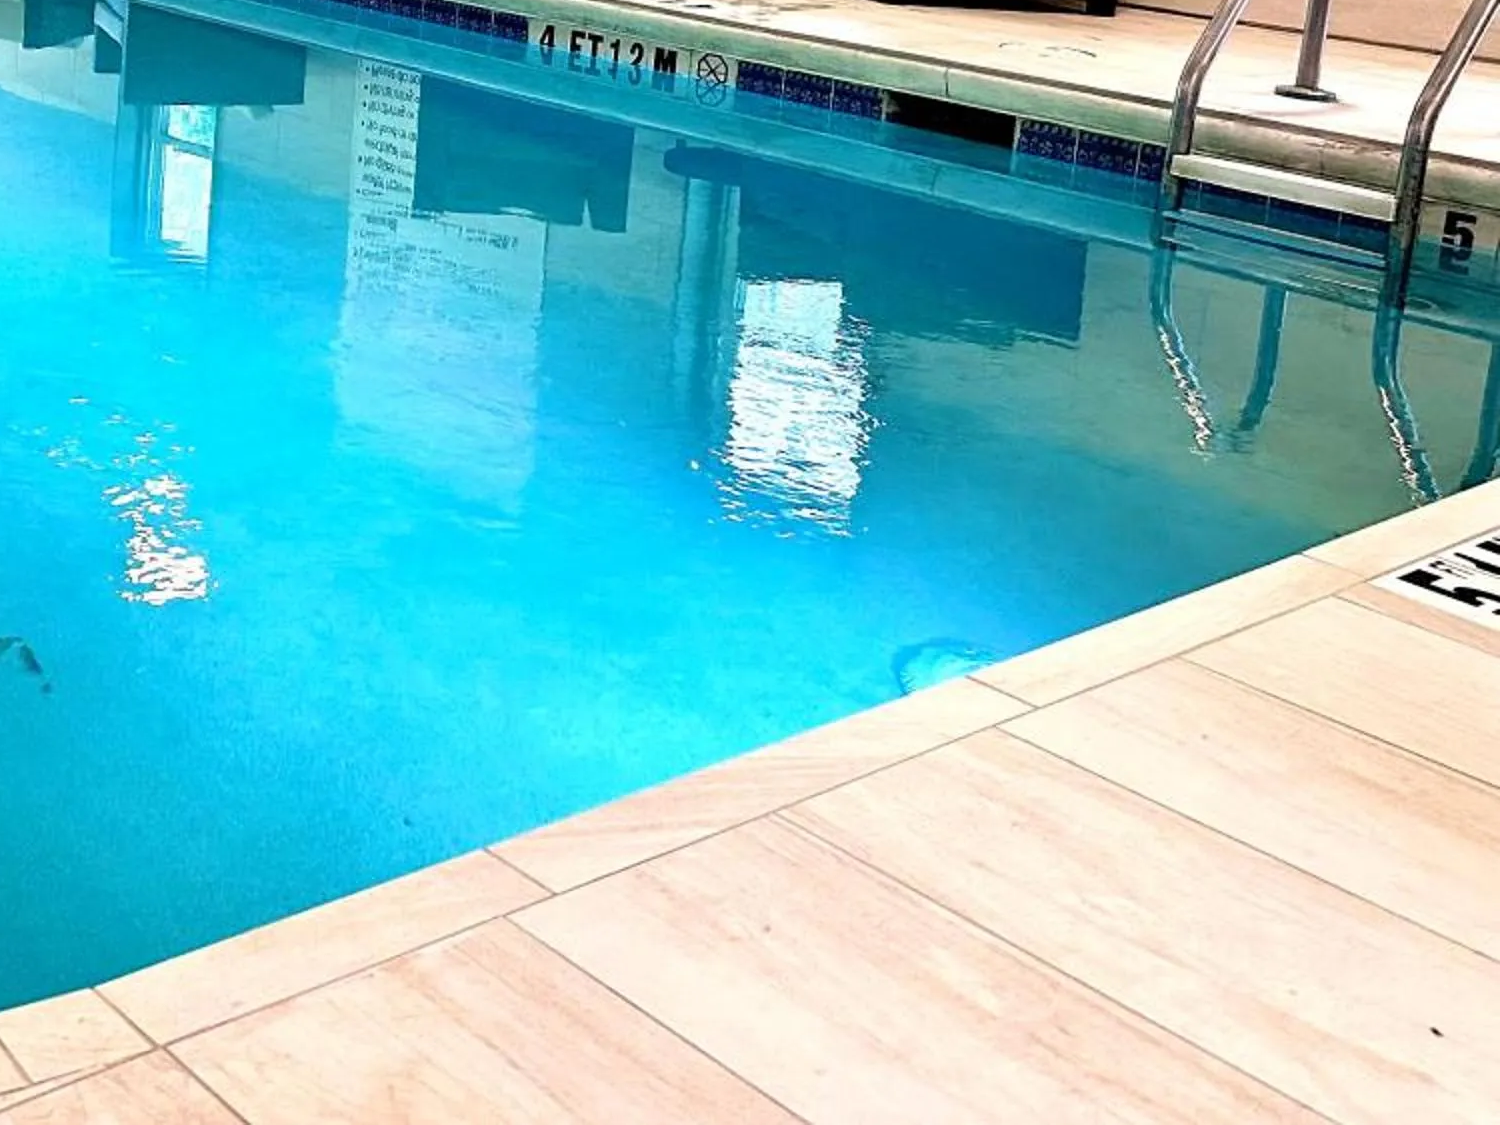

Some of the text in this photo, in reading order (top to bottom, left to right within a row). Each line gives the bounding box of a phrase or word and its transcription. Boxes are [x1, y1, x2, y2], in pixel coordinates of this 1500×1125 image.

[540, 25, 555, 48] 4
[654, 47, 678, 74] M
[1442, 211, 1477, 248] 5
